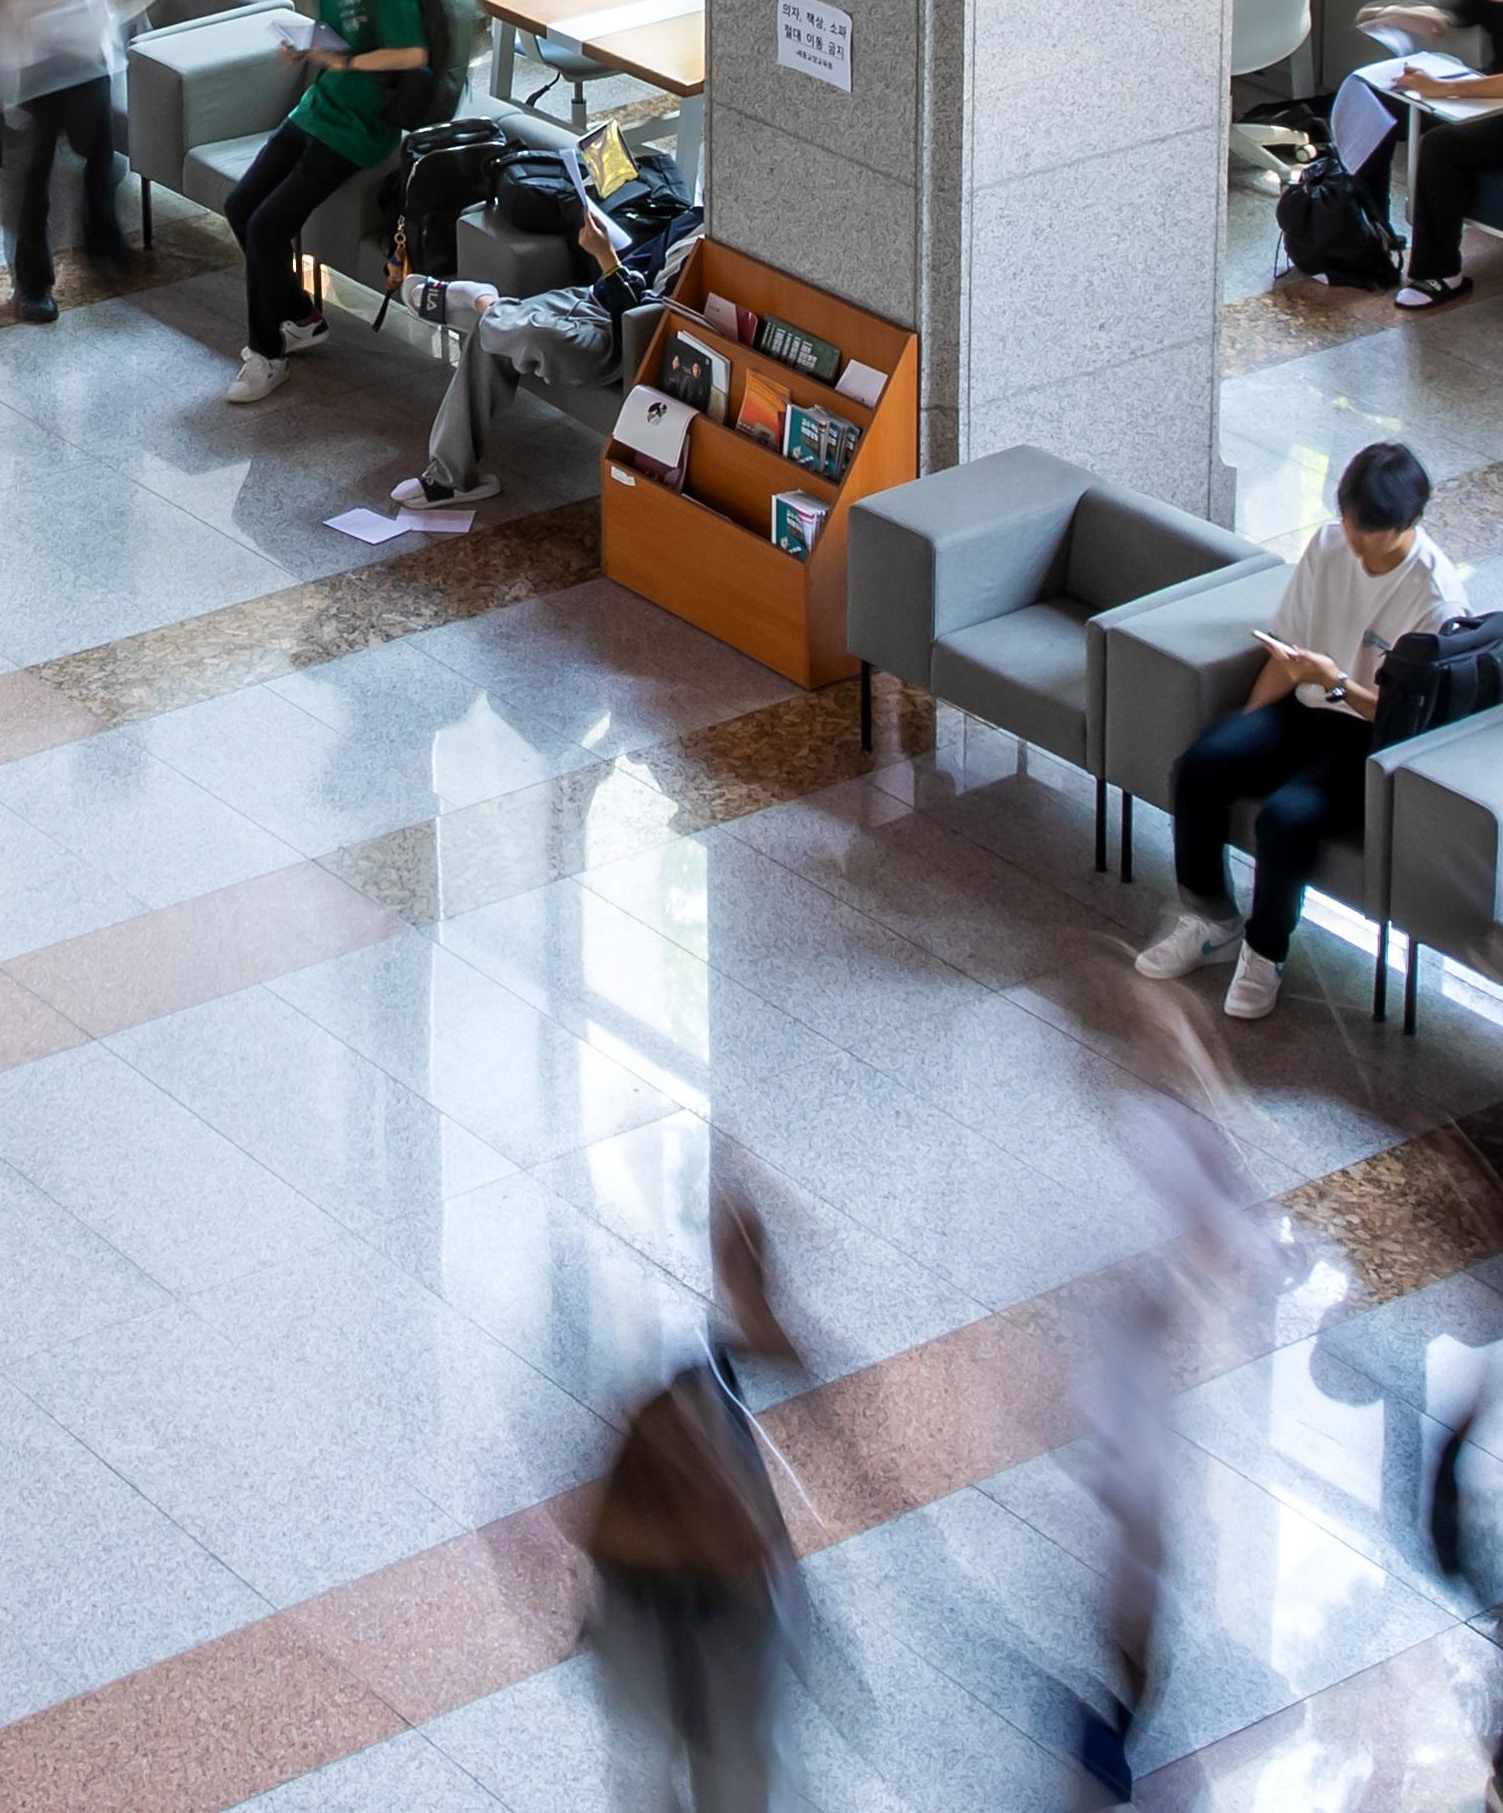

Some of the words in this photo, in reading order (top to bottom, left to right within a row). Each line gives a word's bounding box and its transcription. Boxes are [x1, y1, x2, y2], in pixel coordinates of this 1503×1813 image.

[782, 3, 802, 22] 의자,
[830, 22, 847, 39] 소파
[784, 24, 802, 42] 절대
[806, 33, 823, 51] 이동
[828, 42, 845, 61] 금지
